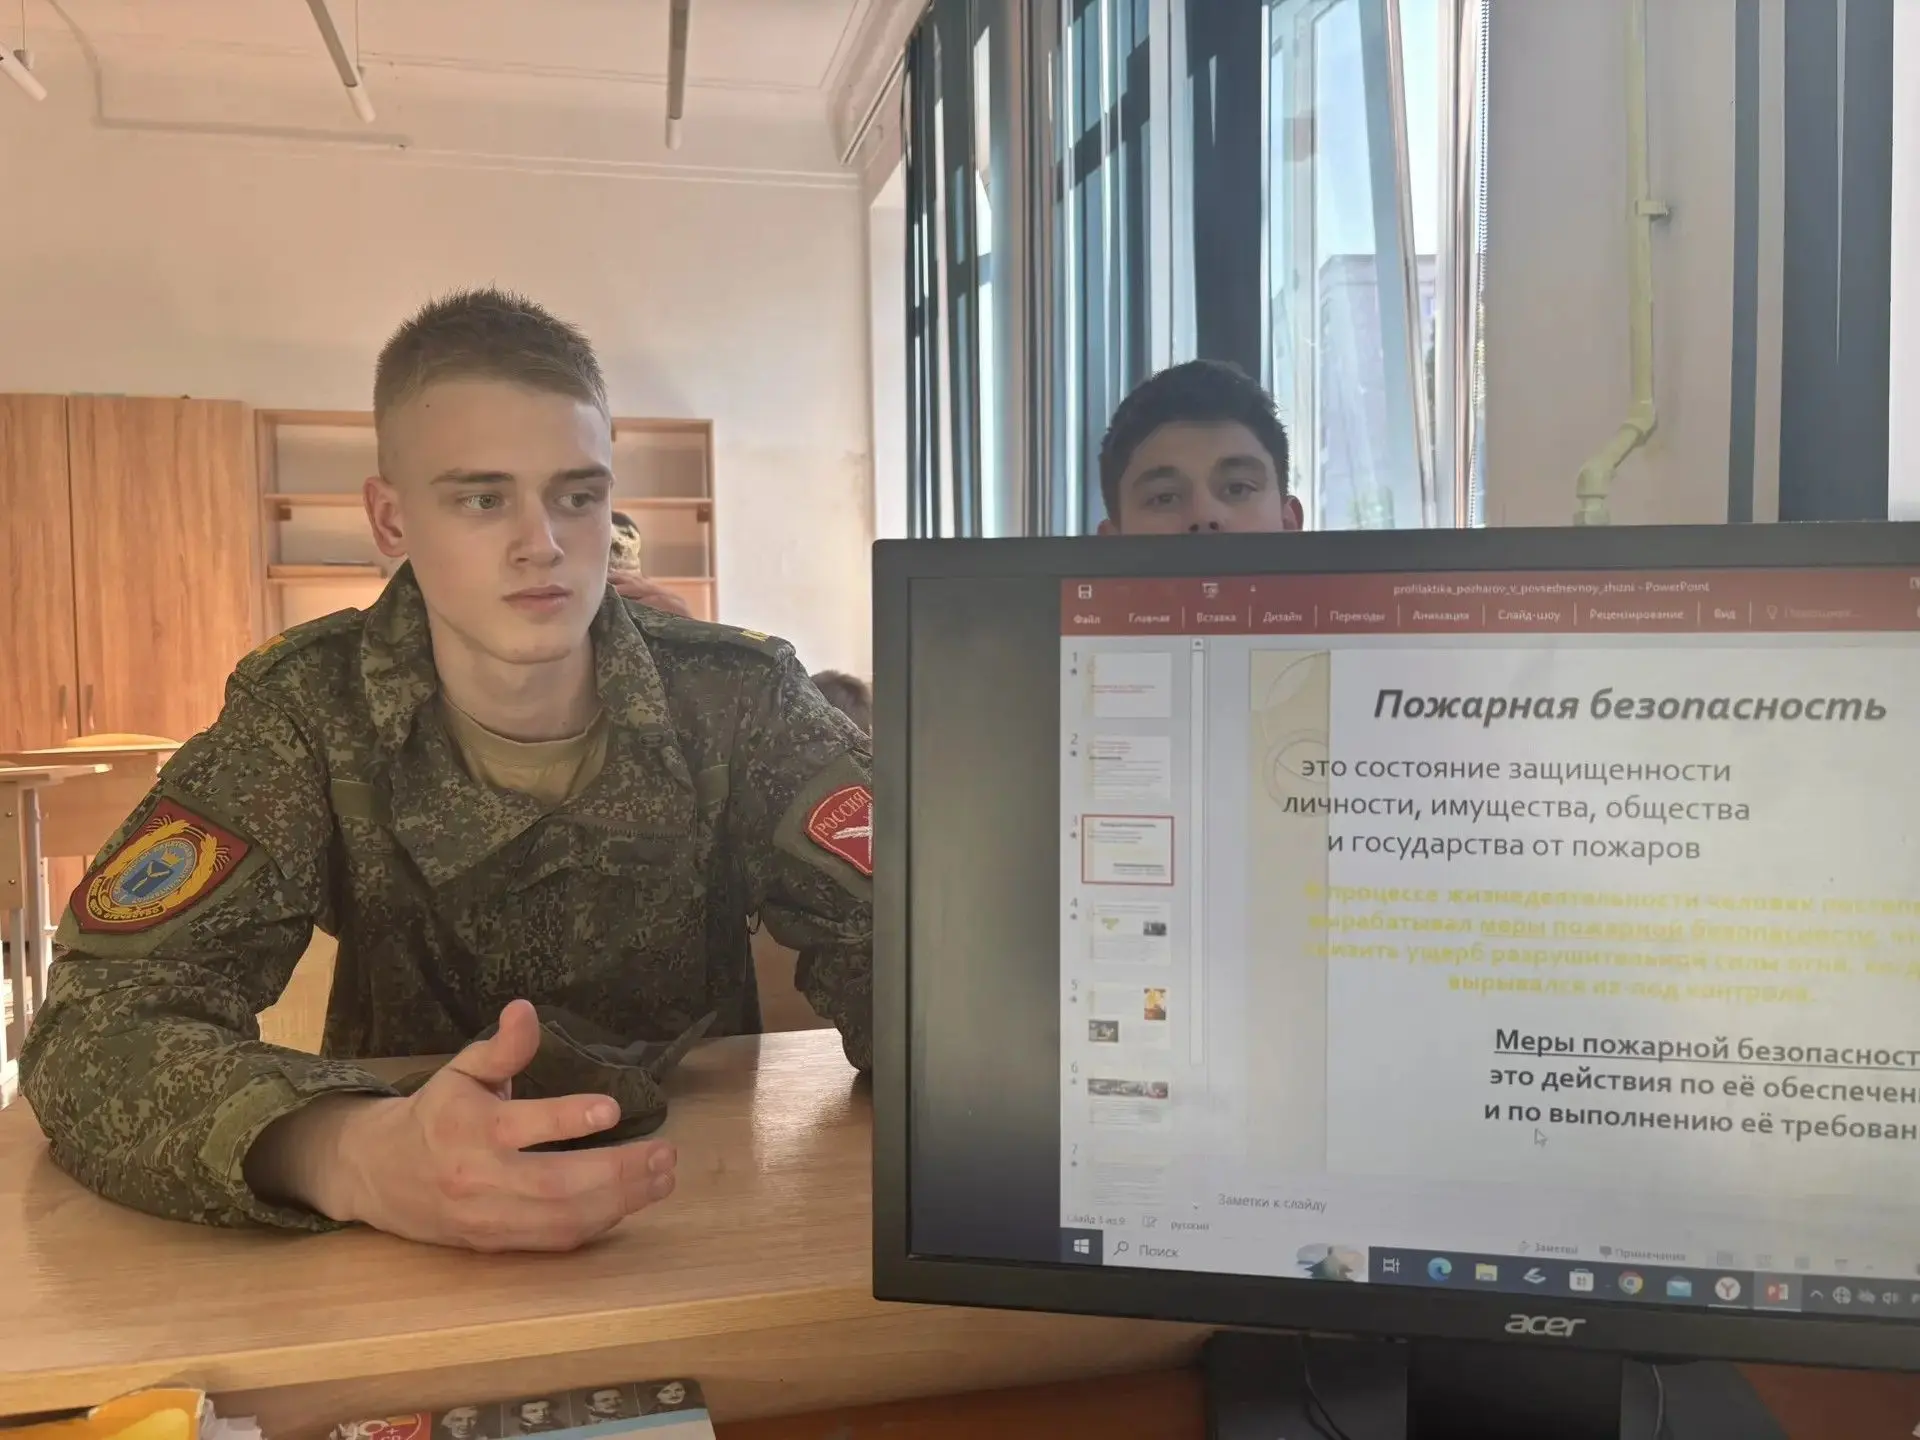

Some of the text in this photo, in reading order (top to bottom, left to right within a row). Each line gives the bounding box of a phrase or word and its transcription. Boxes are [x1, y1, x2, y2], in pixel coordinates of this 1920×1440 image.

[1645, 581, 1710, 593] PowerPoint
[1073, 613, 1101, 625] Файл
[1128, 612, 1170, 624] Главная
[1196, 612, 1237, 624] Вставка
[1263, 611, 1303, 625] Дизайн
[1330, 610, 1386, 624] Переходы
[1412, 610, 1470, 623] Анимация
[1498, 609, 1561, 624] Слайд-шоу
[1589, 608, 1685, 622] Рецензирование
[1714, 607, 1737, 620] Вид
[1374, 686, 1888, 728] Пожарная безопасность
[1070, 733, 1079, 746] 2
[1301, 759, 1731, 785] это состояние защищенности
[813, 791, 869, 837] РОССИЯ
[1282, 794, 1751, 825] личности, имущества, общества
[1327, 834, 1701, 866] и государства от пожаров
[1495, 1028, 1575, 1057] Меры
[1582, 1035, 1729, 1063] пожарной
[1489, 1065, 1920, 1105] это действия по её обеспечен
[1484, 1103, 1500, 1120] и
[1507, 1104, 1542, 1122] по
[1549, 1106, 1734, 1133] выполнению
[1740, 1111, 1774, 1135] её
[1217, 1193, 1328, 1213] Заметки к слайду
[1138, 1243, 1180, 1259] Поиск
[1504, 1313, 1587, 1338] acer
